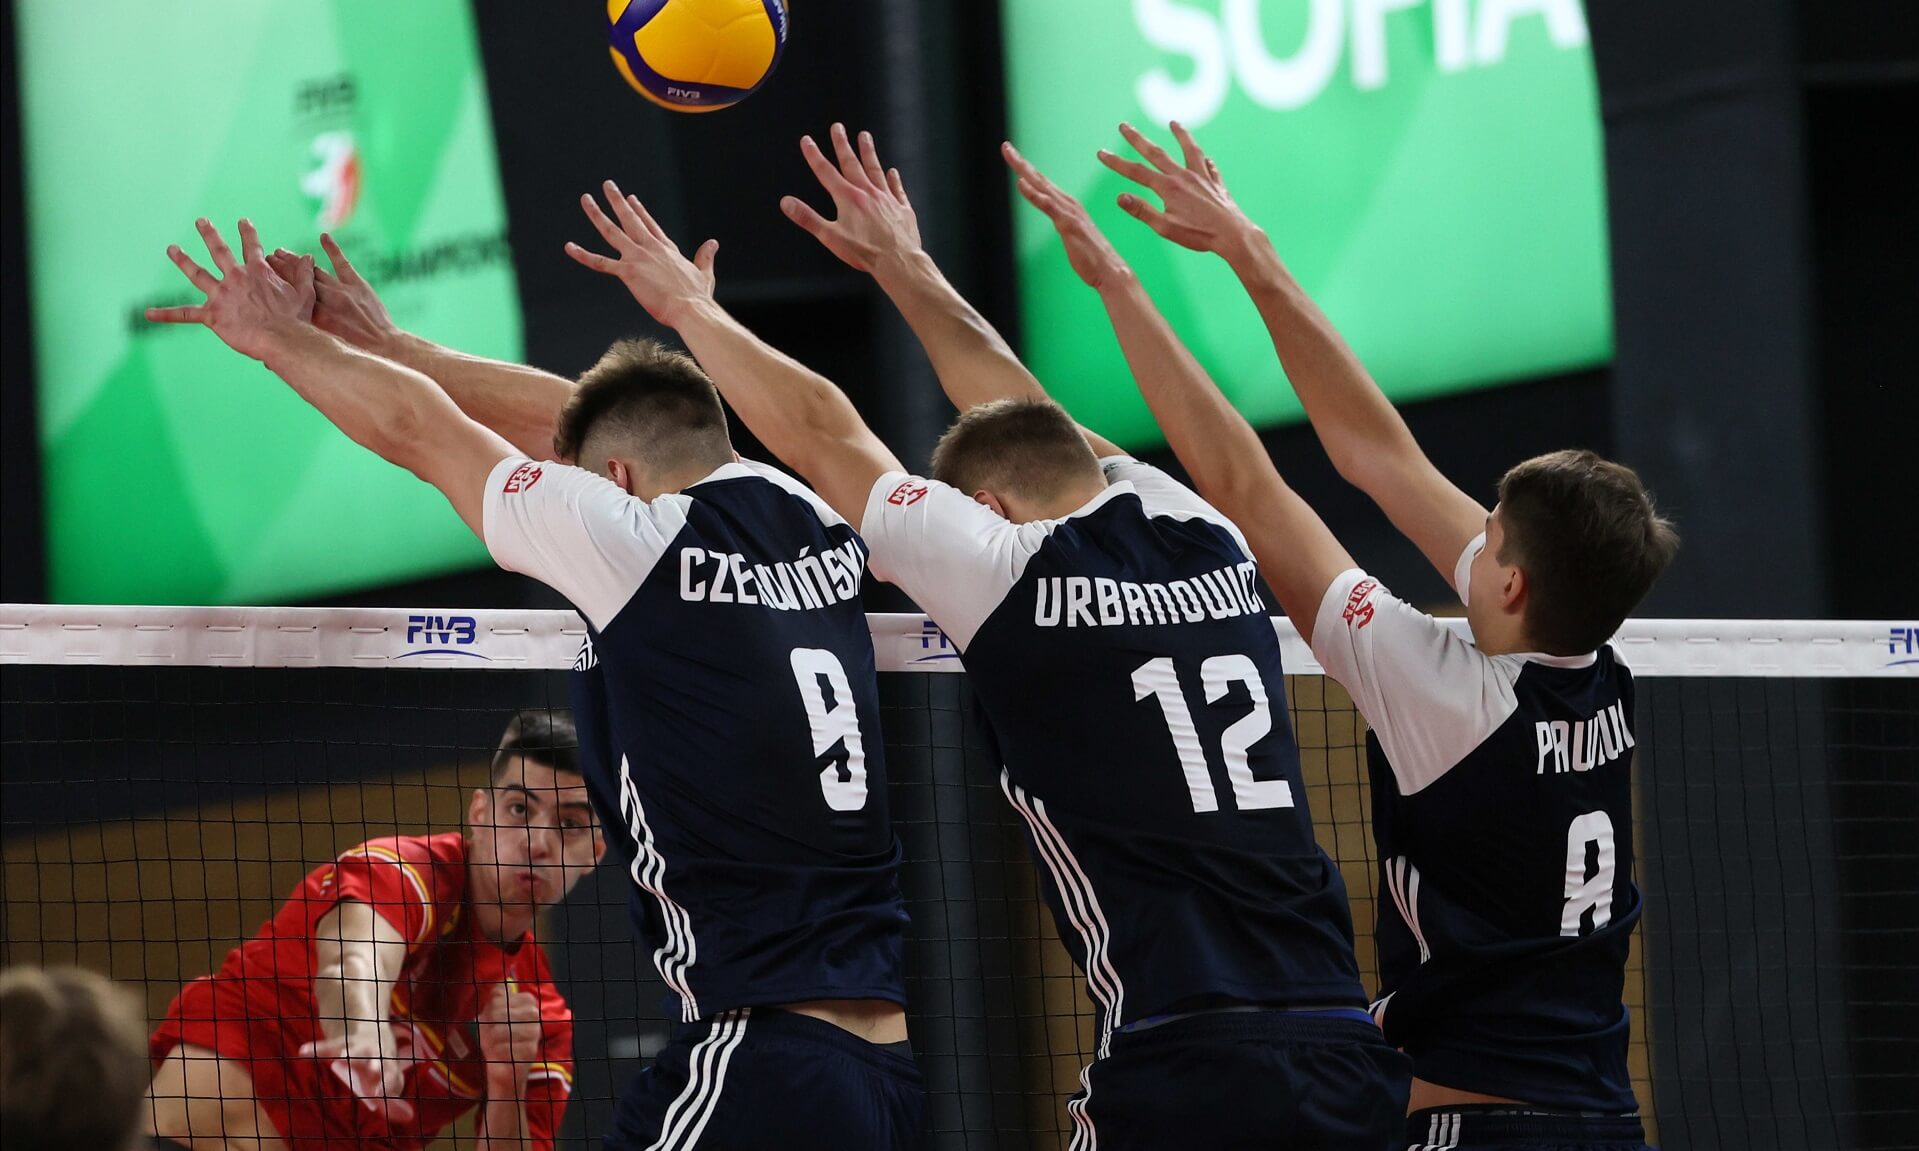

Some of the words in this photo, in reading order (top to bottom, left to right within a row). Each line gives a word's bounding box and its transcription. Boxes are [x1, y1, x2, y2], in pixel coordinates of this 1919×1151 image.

[407, 615, 477, 645] FIVB
[790, 648, 868, 812] 9
[1130, 654, 1295, 813] 12
